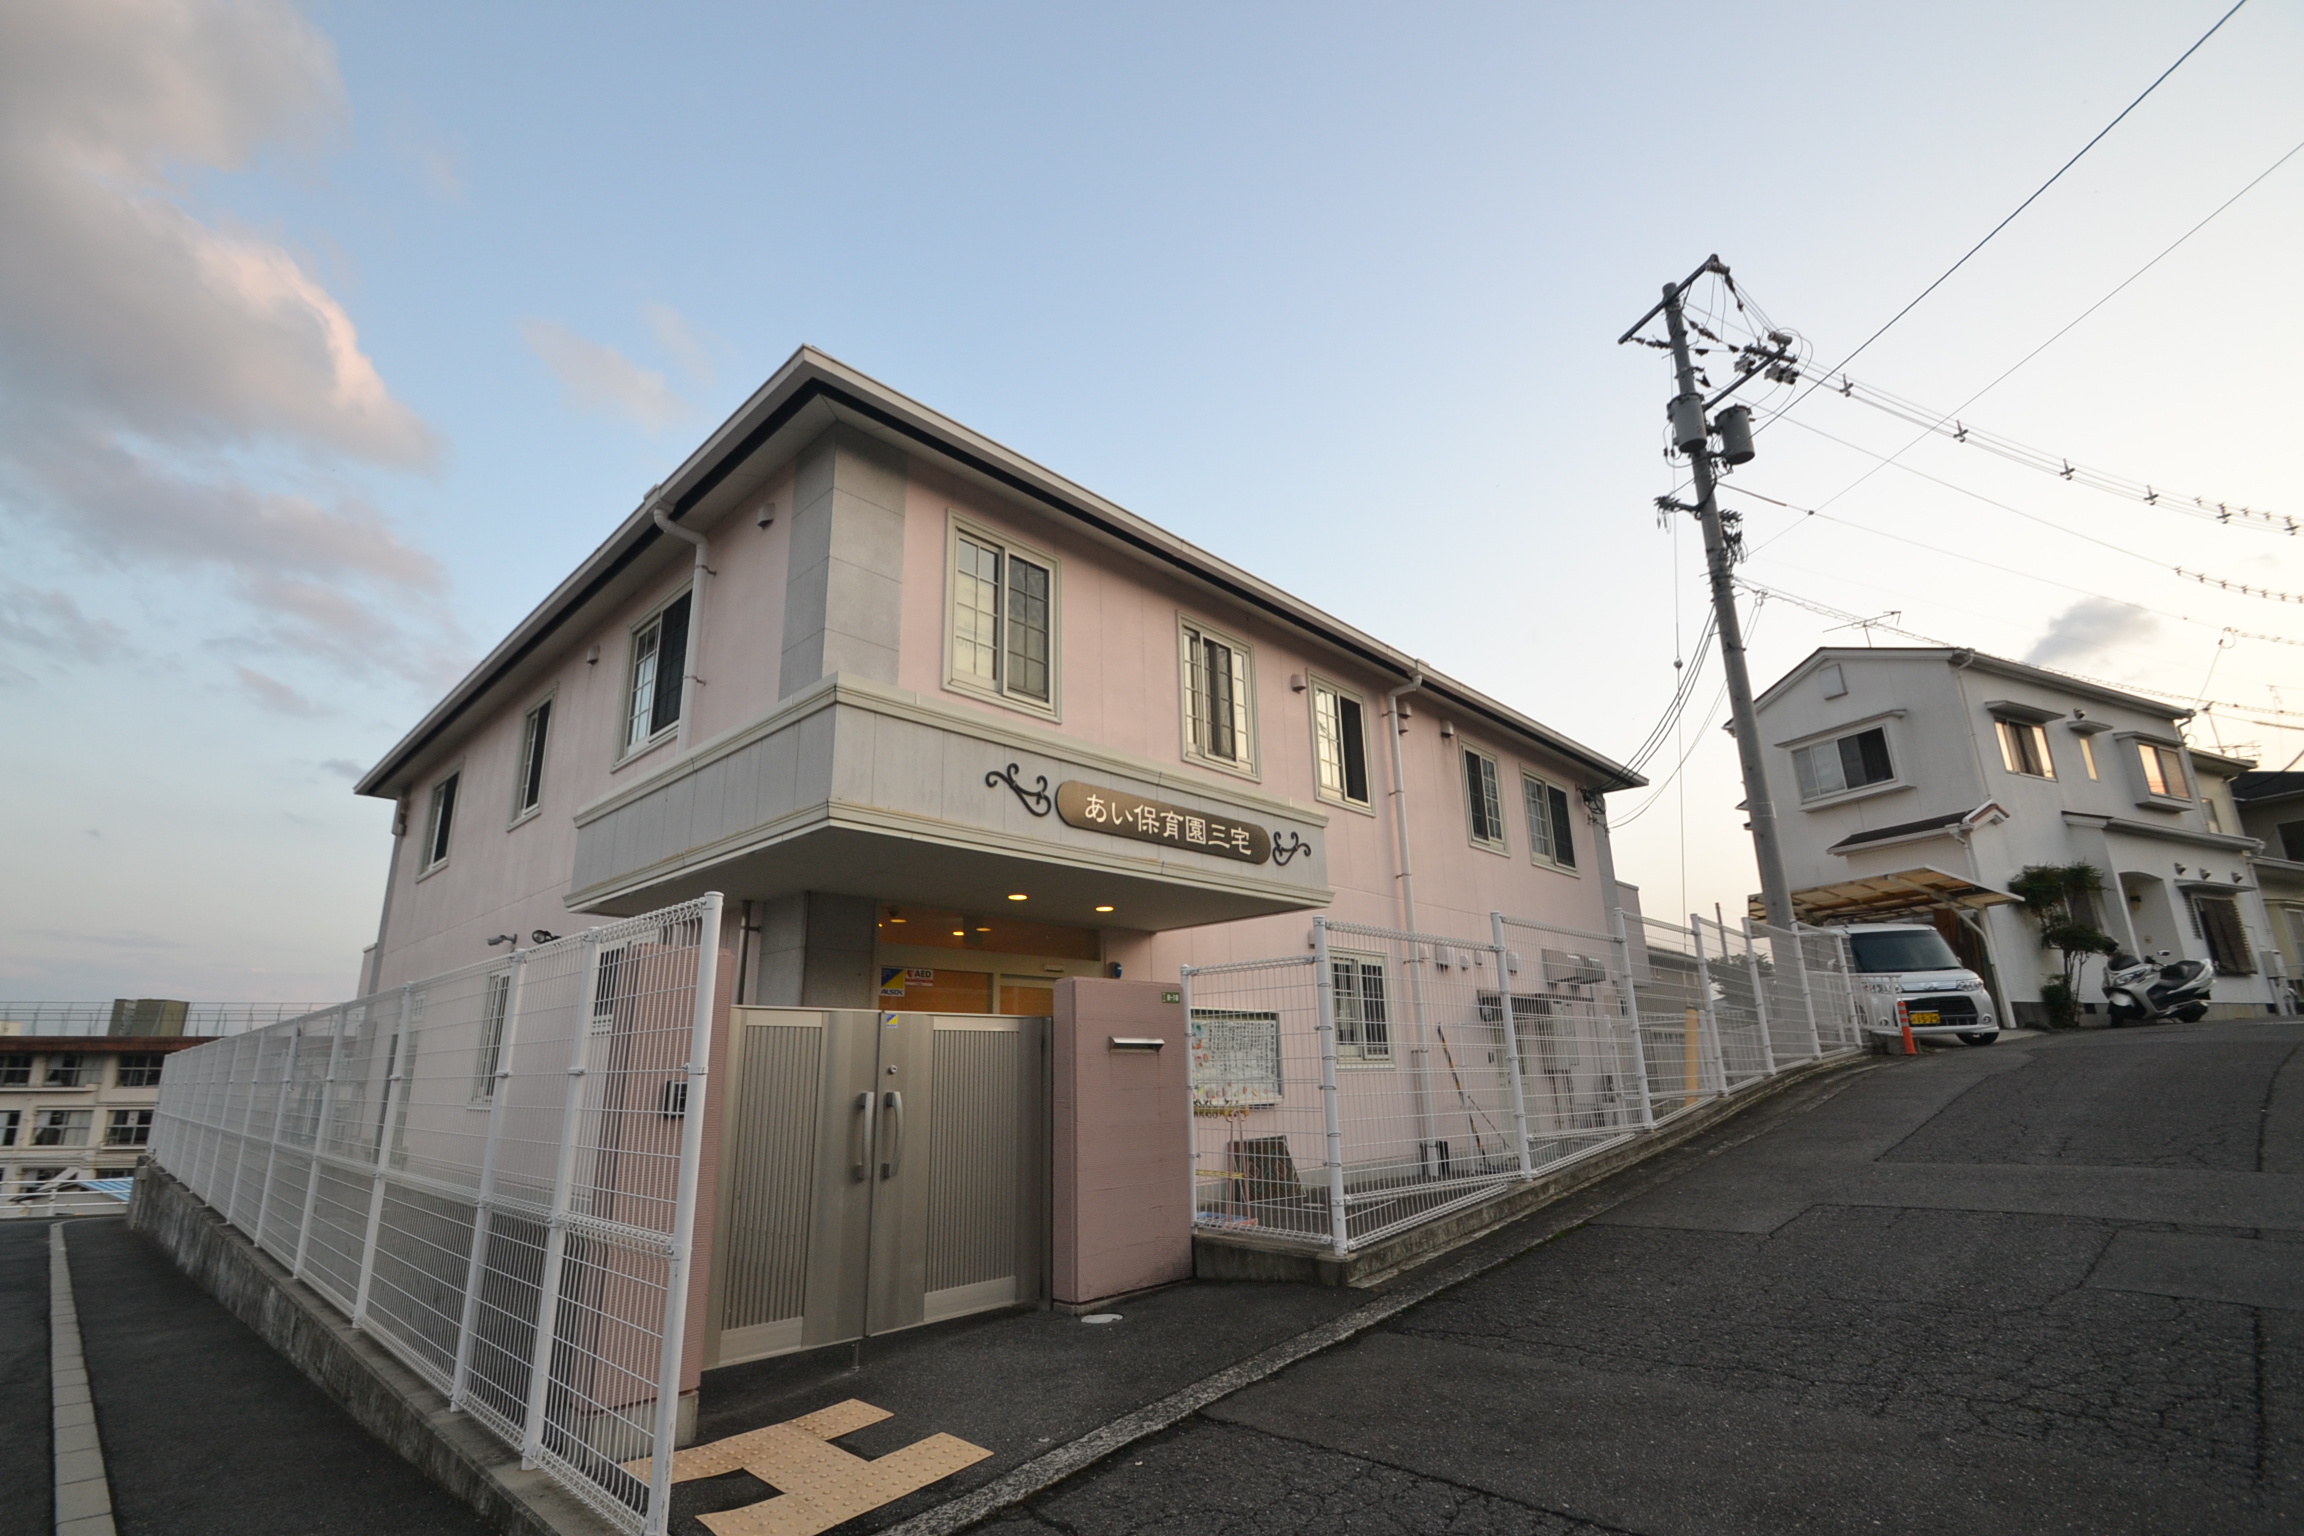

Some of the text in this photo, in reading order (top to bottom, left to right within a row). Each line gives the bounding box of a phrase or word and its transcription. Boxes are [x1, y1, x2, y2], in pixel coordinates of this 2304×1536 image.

[1084, 793, 1252, 856] あい保育園三宅
[914, 970, 931, 978] AED
[881, 988, 903, 996] ALSOK
